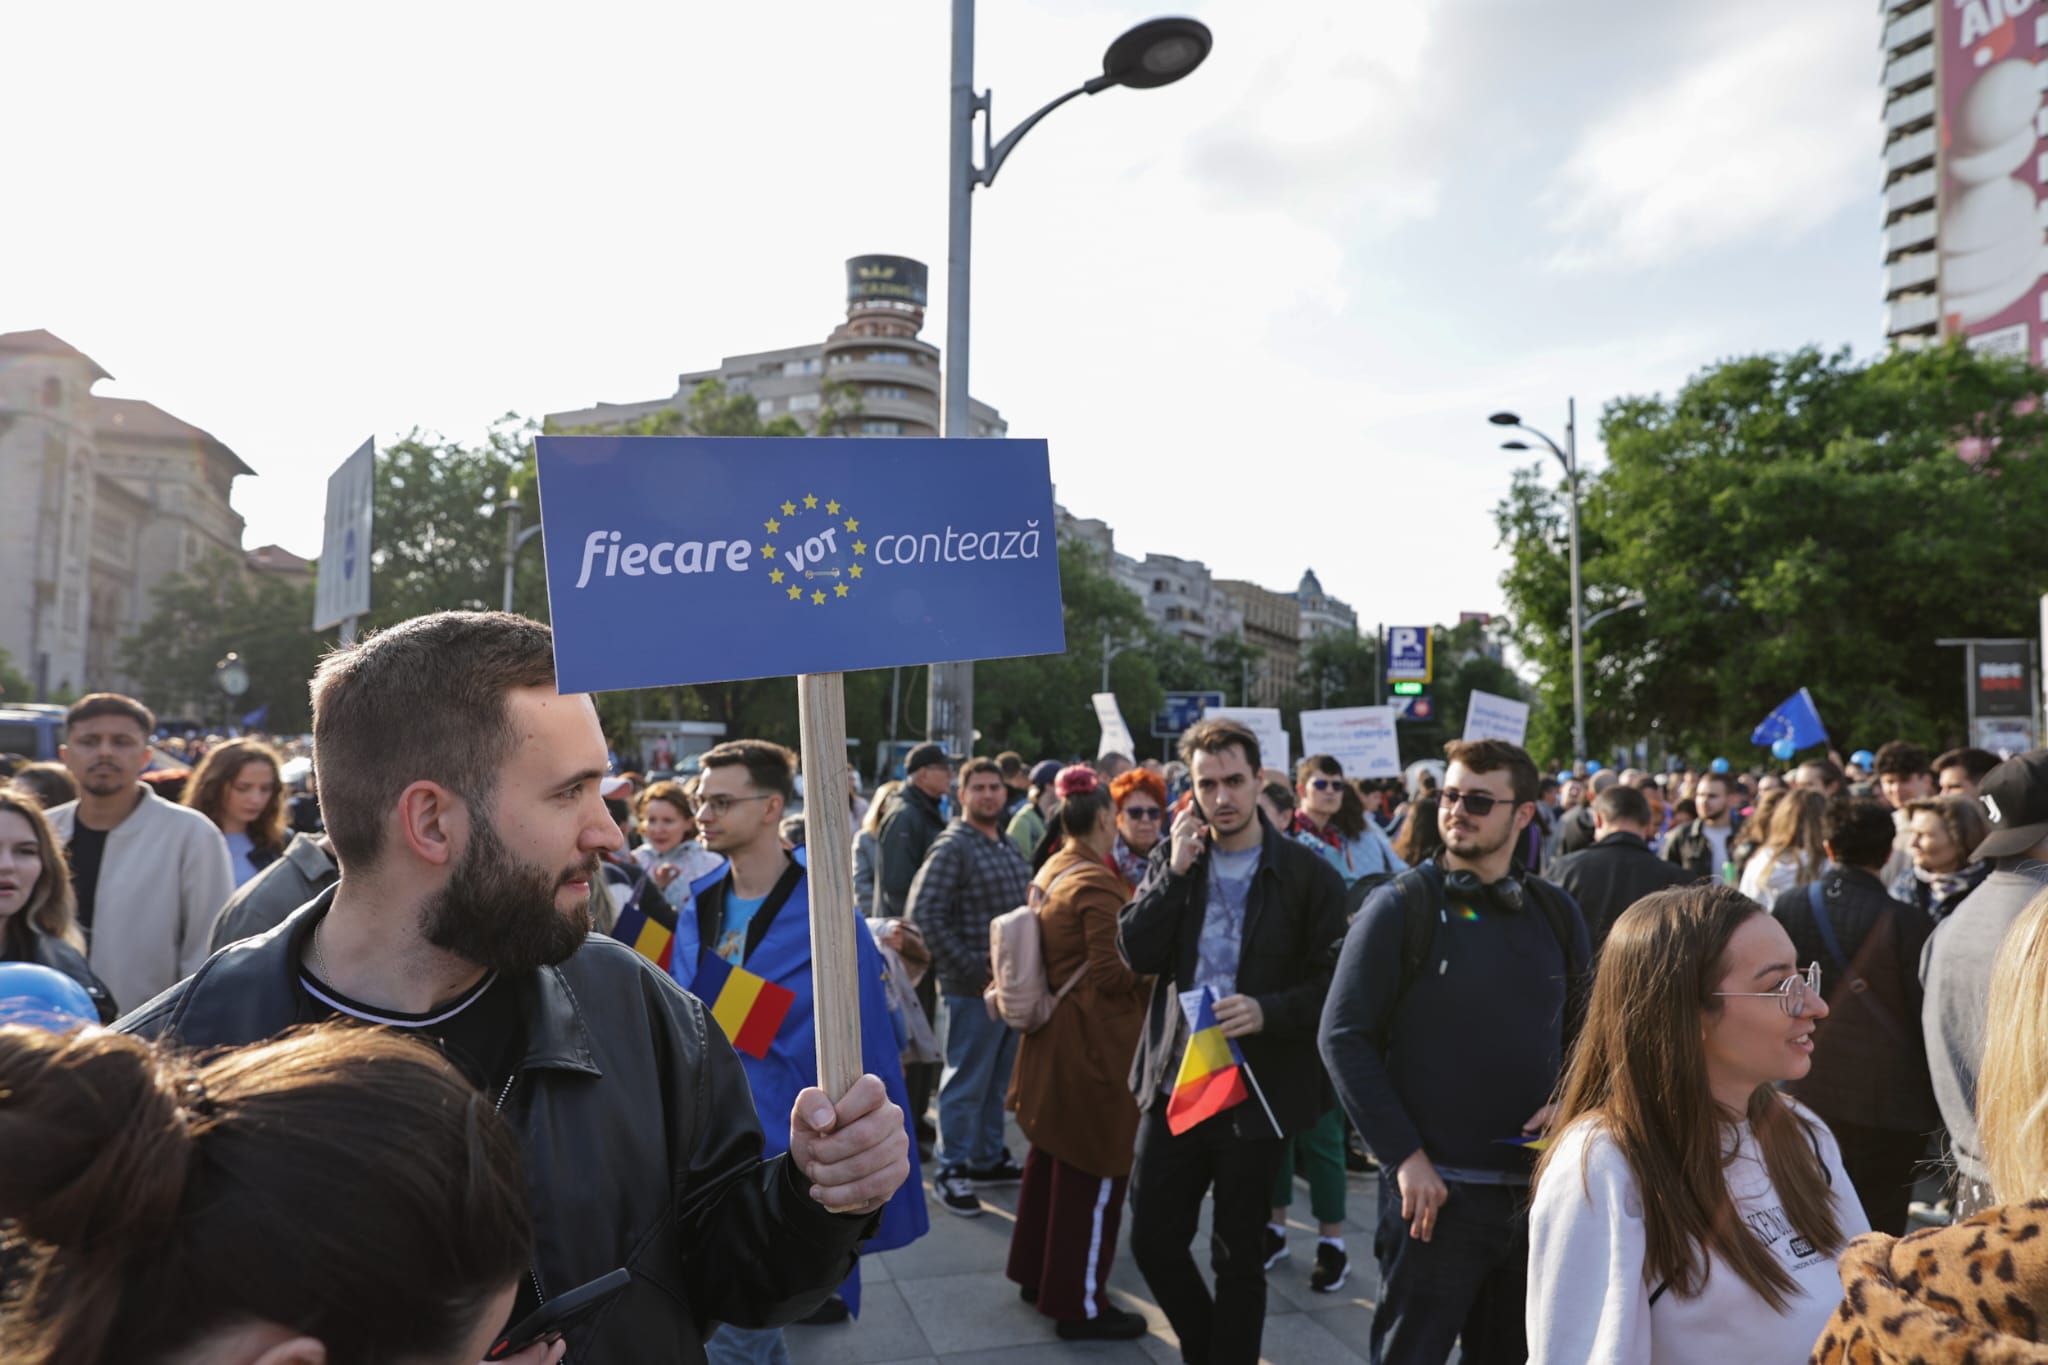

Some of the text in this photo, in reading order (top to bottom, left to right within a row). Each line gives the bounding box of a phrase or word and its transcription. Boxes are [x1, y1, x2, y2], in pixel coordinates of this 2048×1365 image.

[576, 520, 1040, 588] fiecare VOT contează
